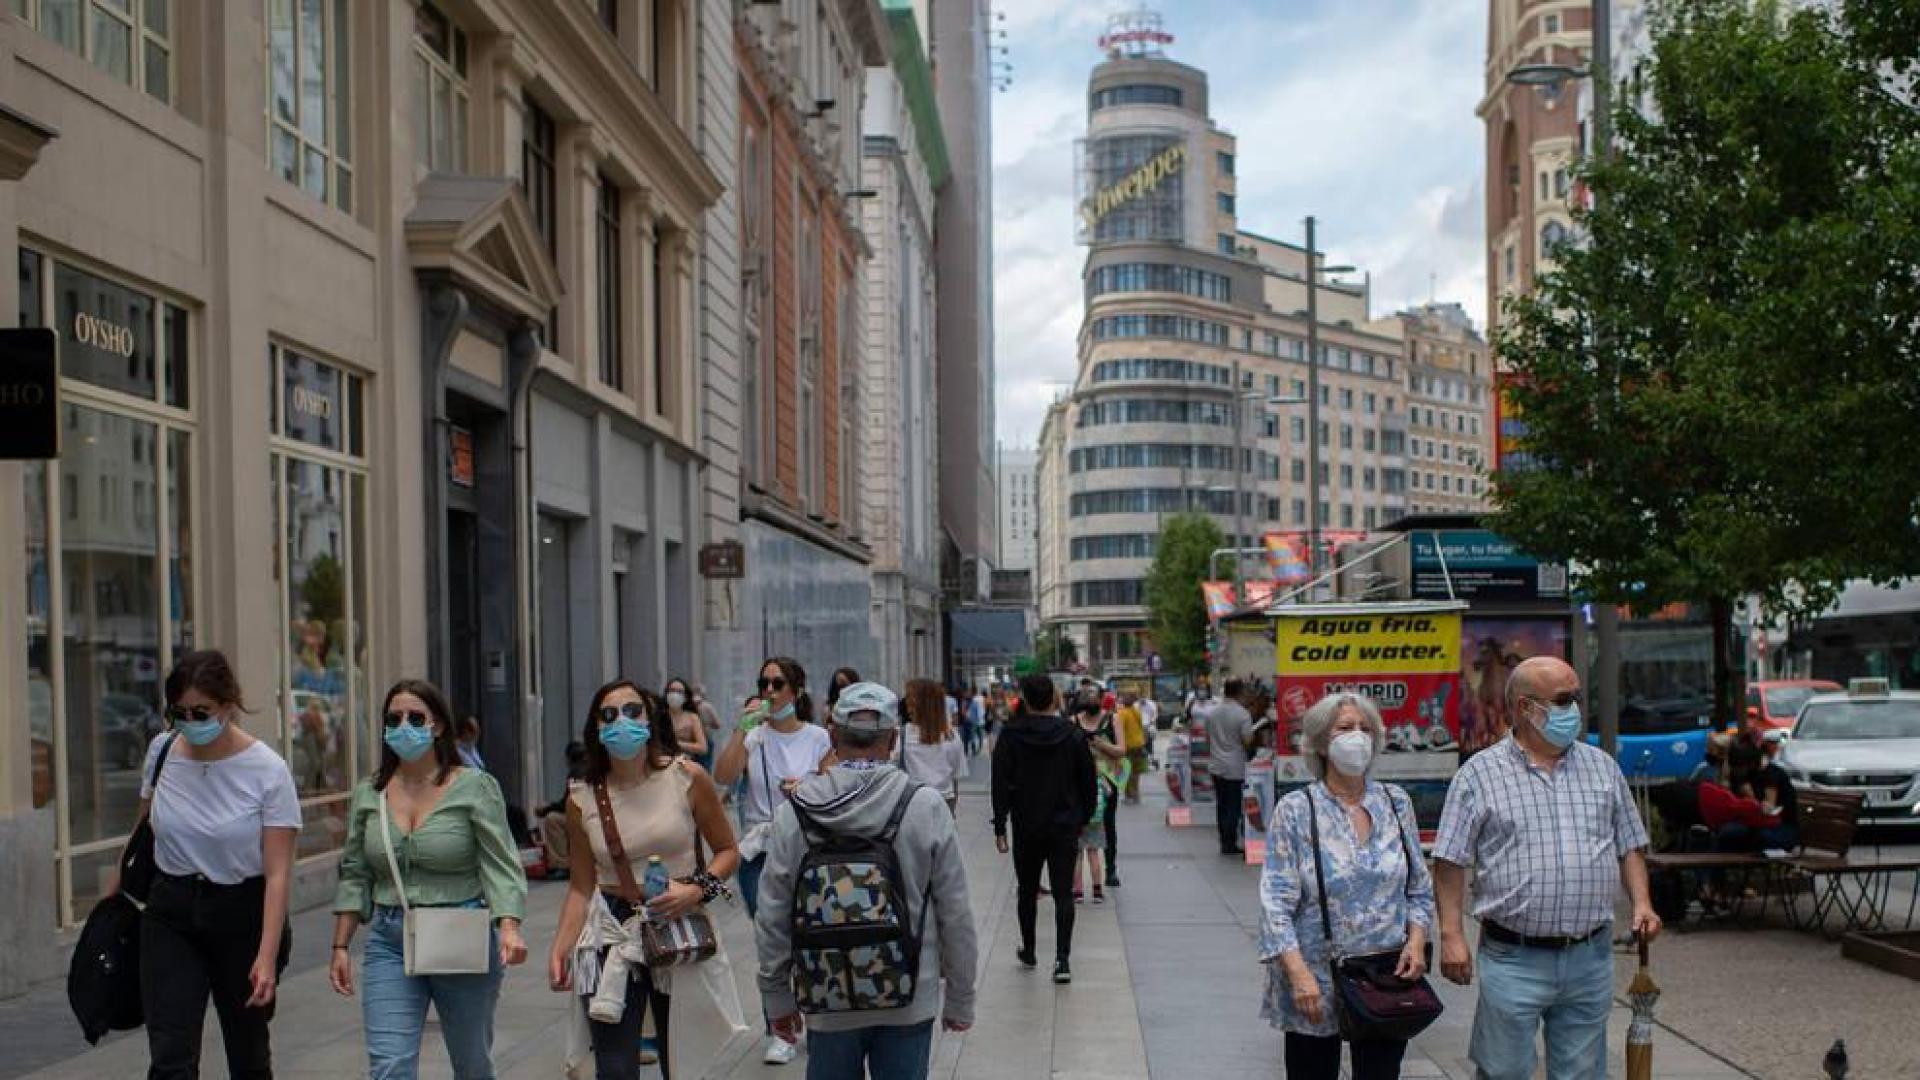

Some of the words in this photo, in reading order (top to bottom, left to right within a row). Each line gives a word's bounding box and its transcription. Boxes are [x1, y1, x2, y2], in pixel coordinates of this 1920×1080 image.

[75, 311, 134, 357] OYSHO
[1299, 618, 1371, 636] Agua
[1291, 644, 1350, 662] Cold
[1359, 643, 1445, 661] water.
